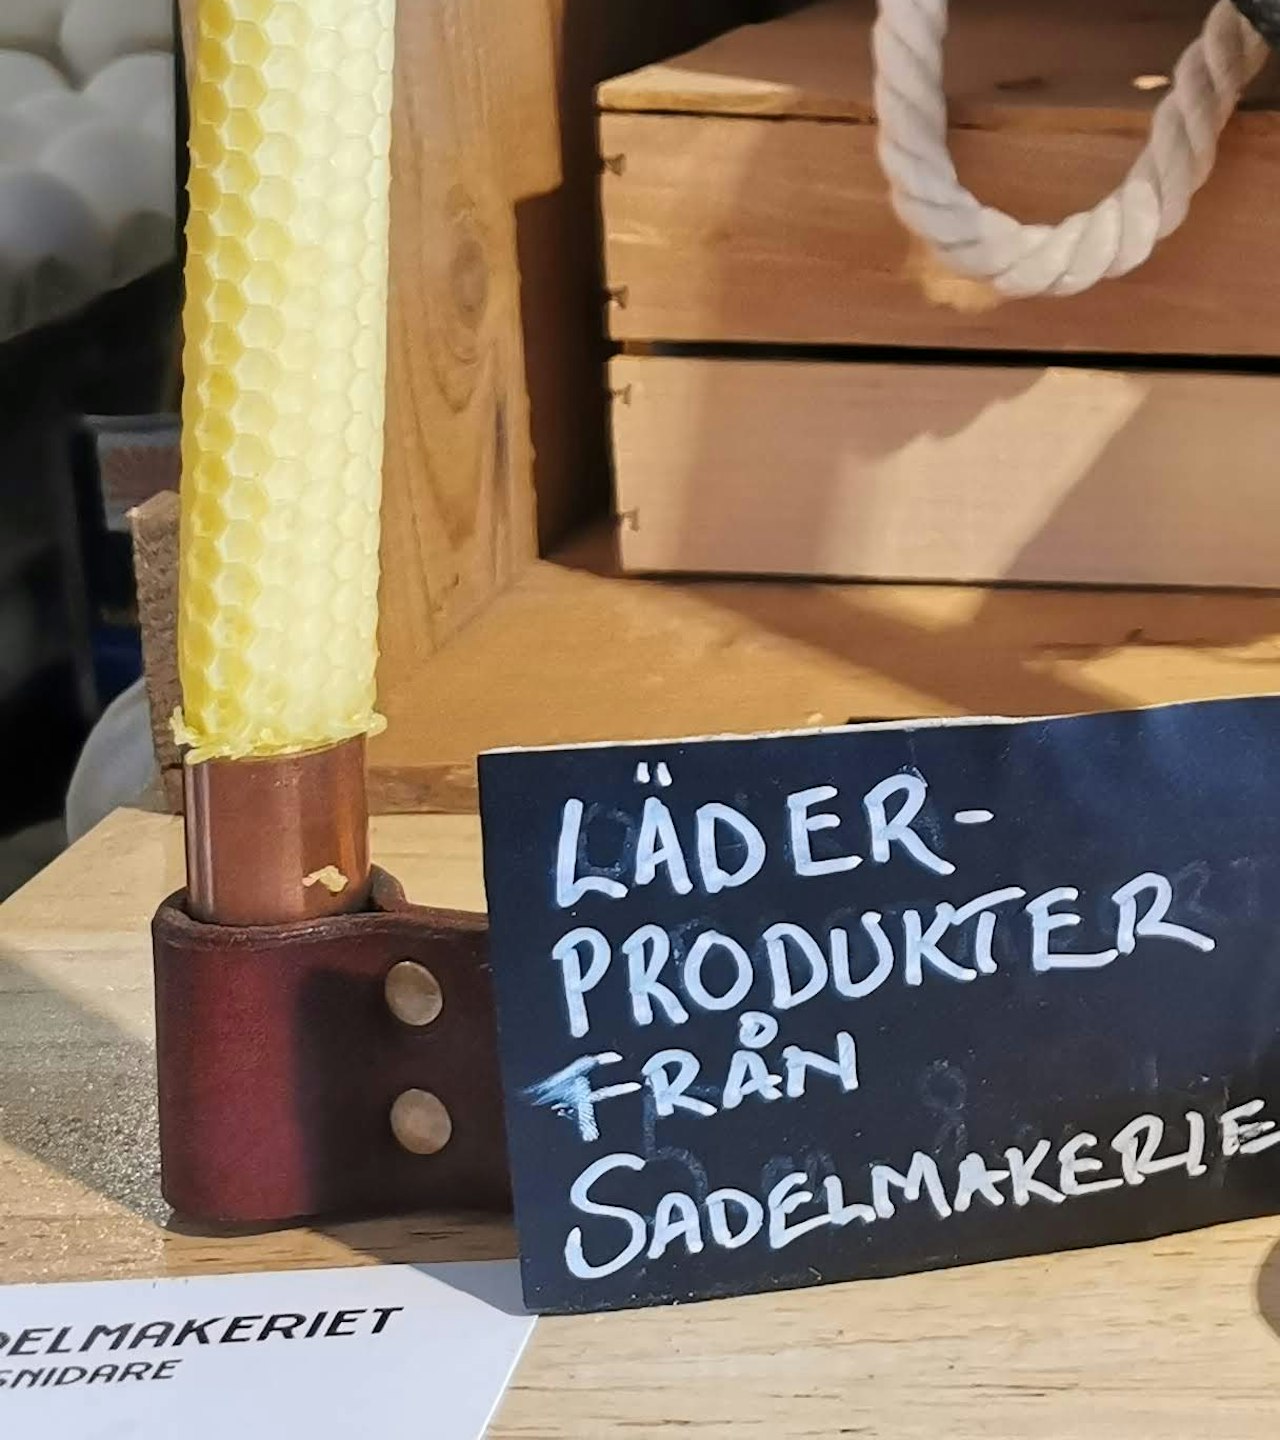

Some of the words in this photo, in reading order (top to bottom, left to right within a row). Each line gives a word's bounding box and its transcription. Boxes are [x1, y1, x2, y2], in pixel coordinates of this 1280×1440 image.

[554, 762, 994, 908] LÄDER-
[551, 871, 1216, 1038] PRODUKTER
[532, 1012, 858, 1142] FRÅN
